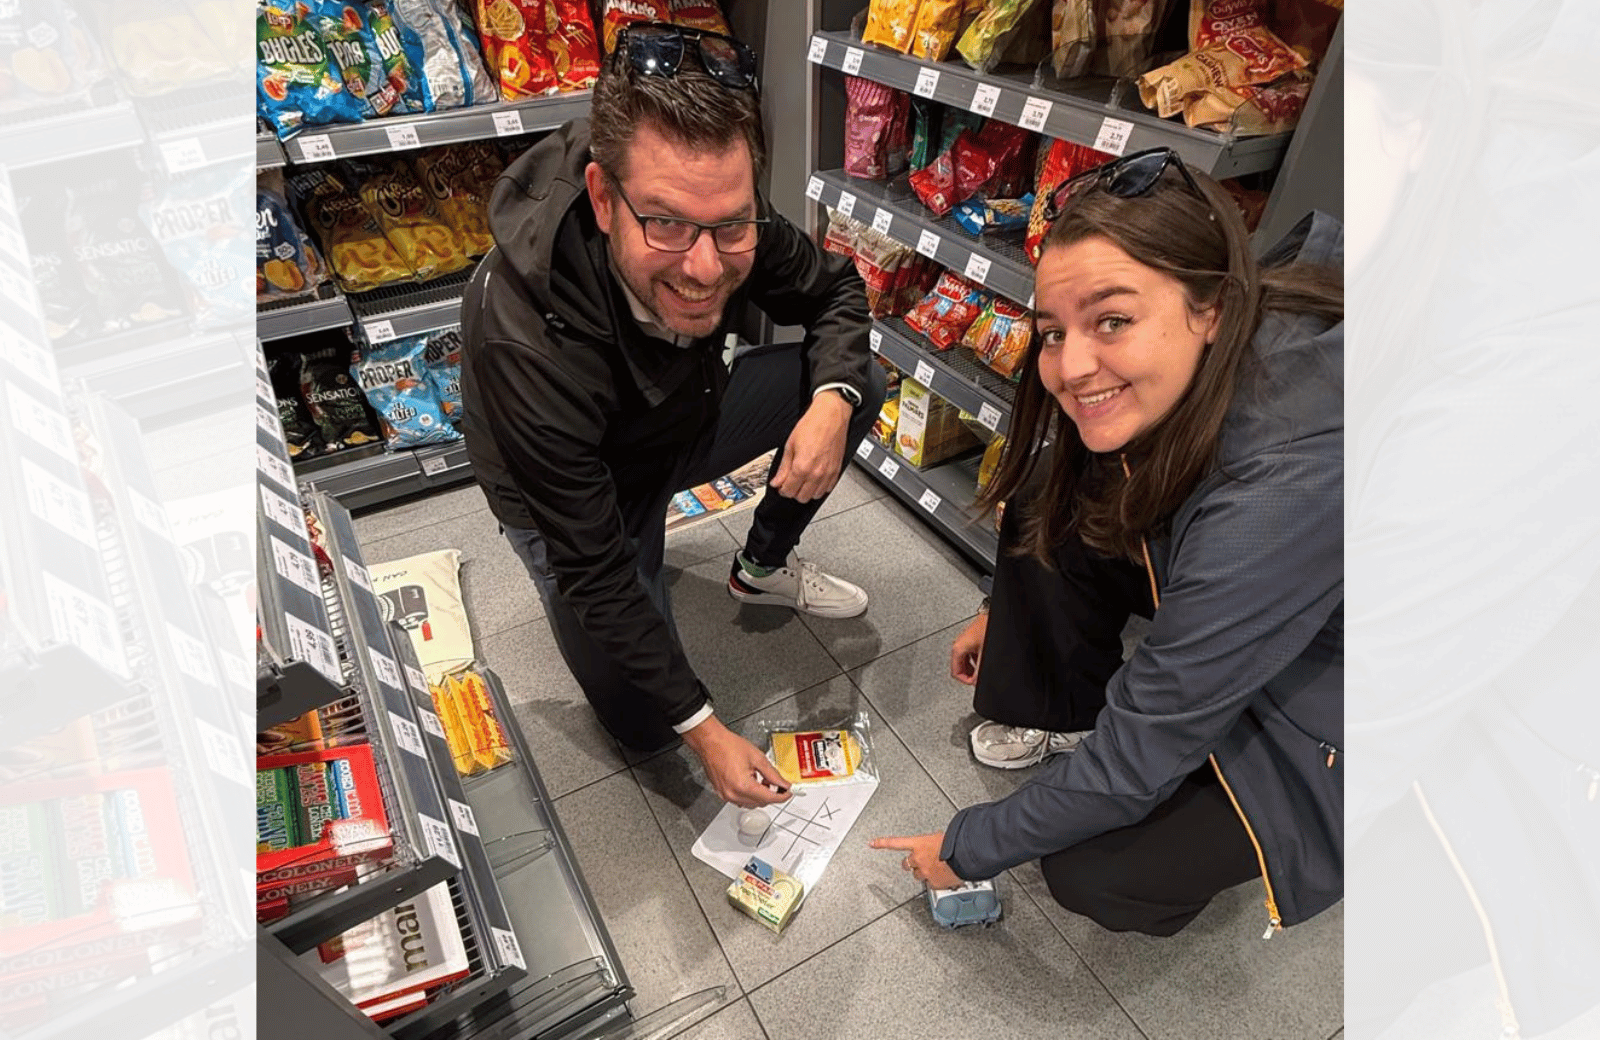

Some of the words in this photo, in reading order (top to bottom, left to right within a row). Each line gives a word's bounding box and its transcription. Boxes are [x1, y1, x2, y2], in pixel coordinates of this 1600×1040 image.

[259, 30, 324, 64] BUGLES
[359, 360, 414, 389] PROPER
[257, 853, 368, 881] COLONELY
